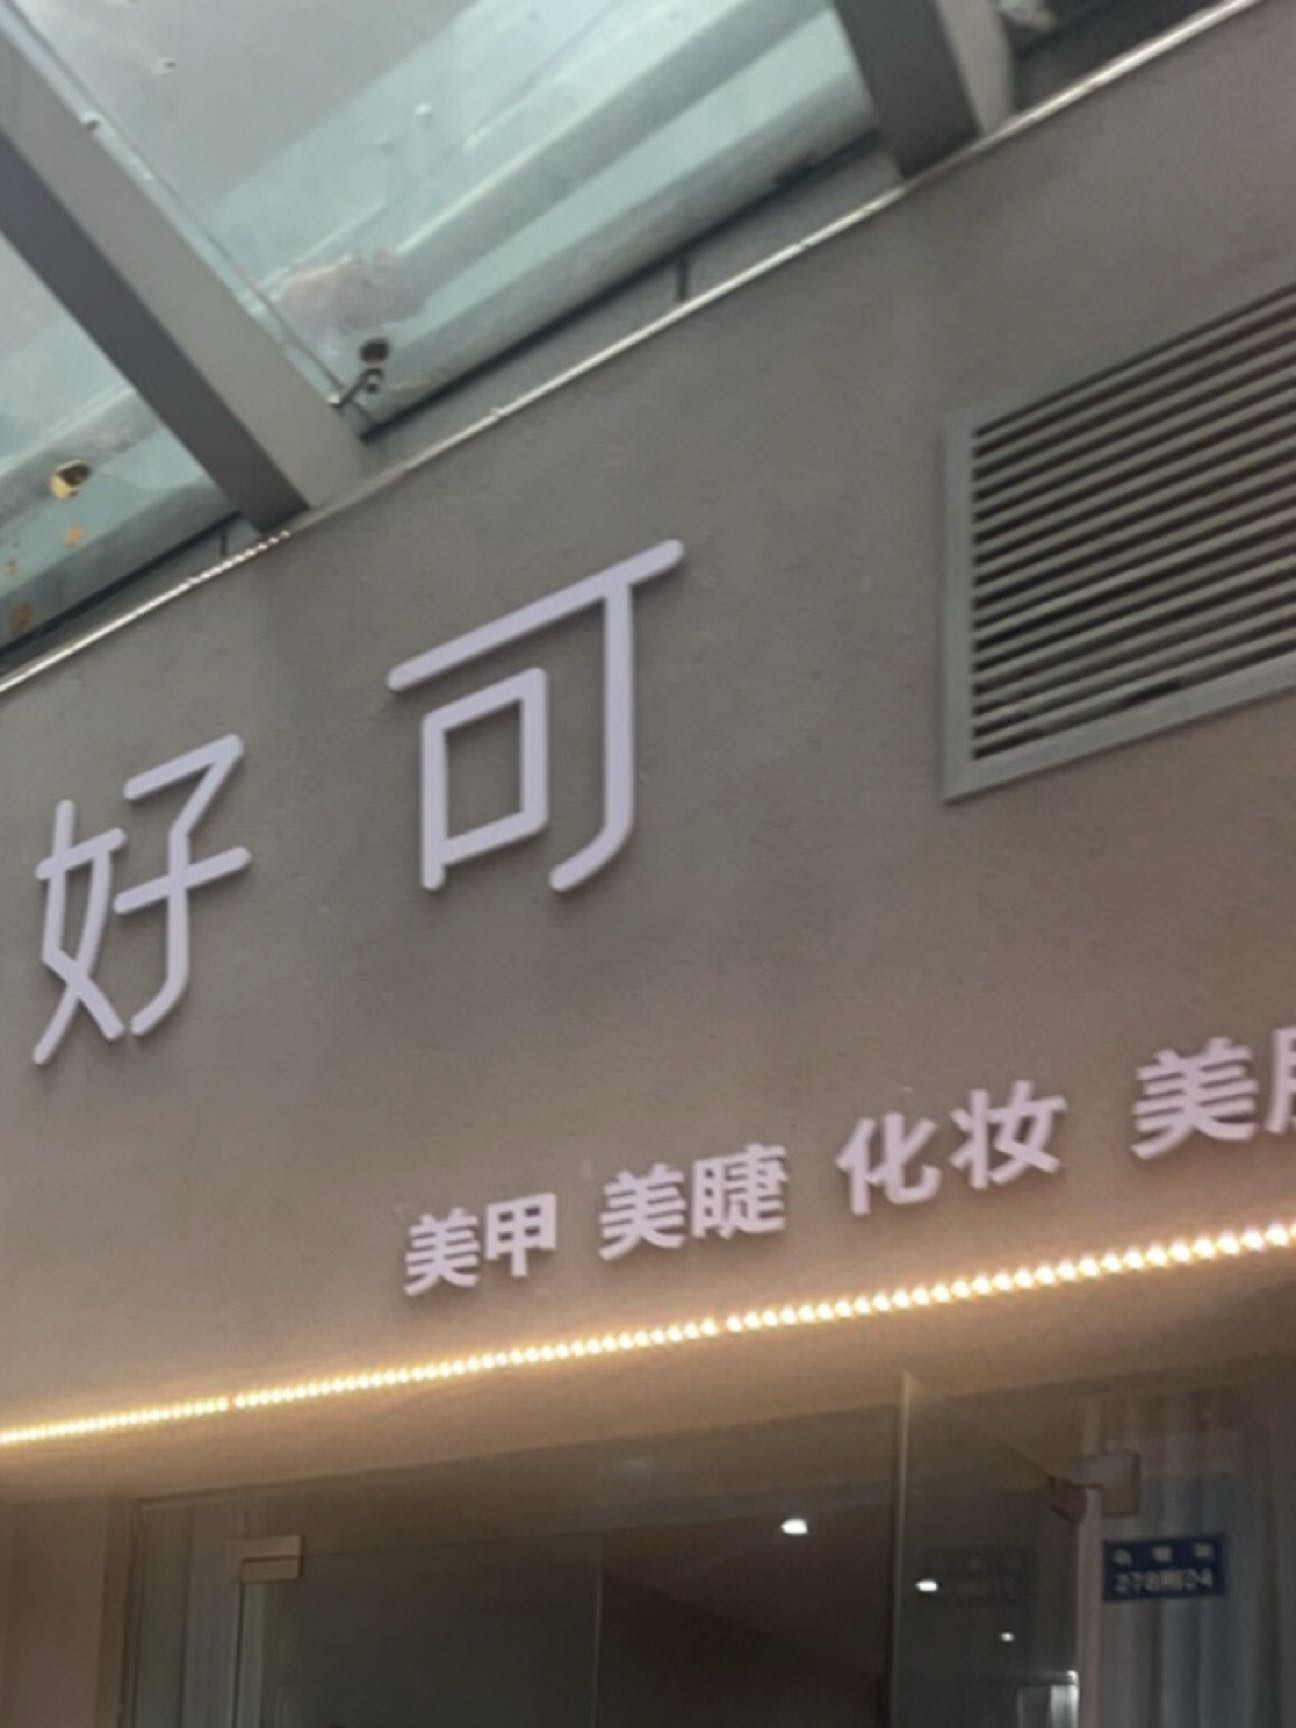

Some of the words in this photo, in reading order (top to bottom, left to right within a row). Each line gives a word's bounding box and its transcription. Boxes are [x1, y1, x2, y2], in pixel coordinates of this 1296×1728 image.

[34, 539, 684, 1065] 好可
[402, 1193, 557, 1296] 美甲
[597, 1143, 787, 1261] 美睫
[835, 1080, 1067, 1215] 化妆
[1129, 1026, 1296, 1160] 美
